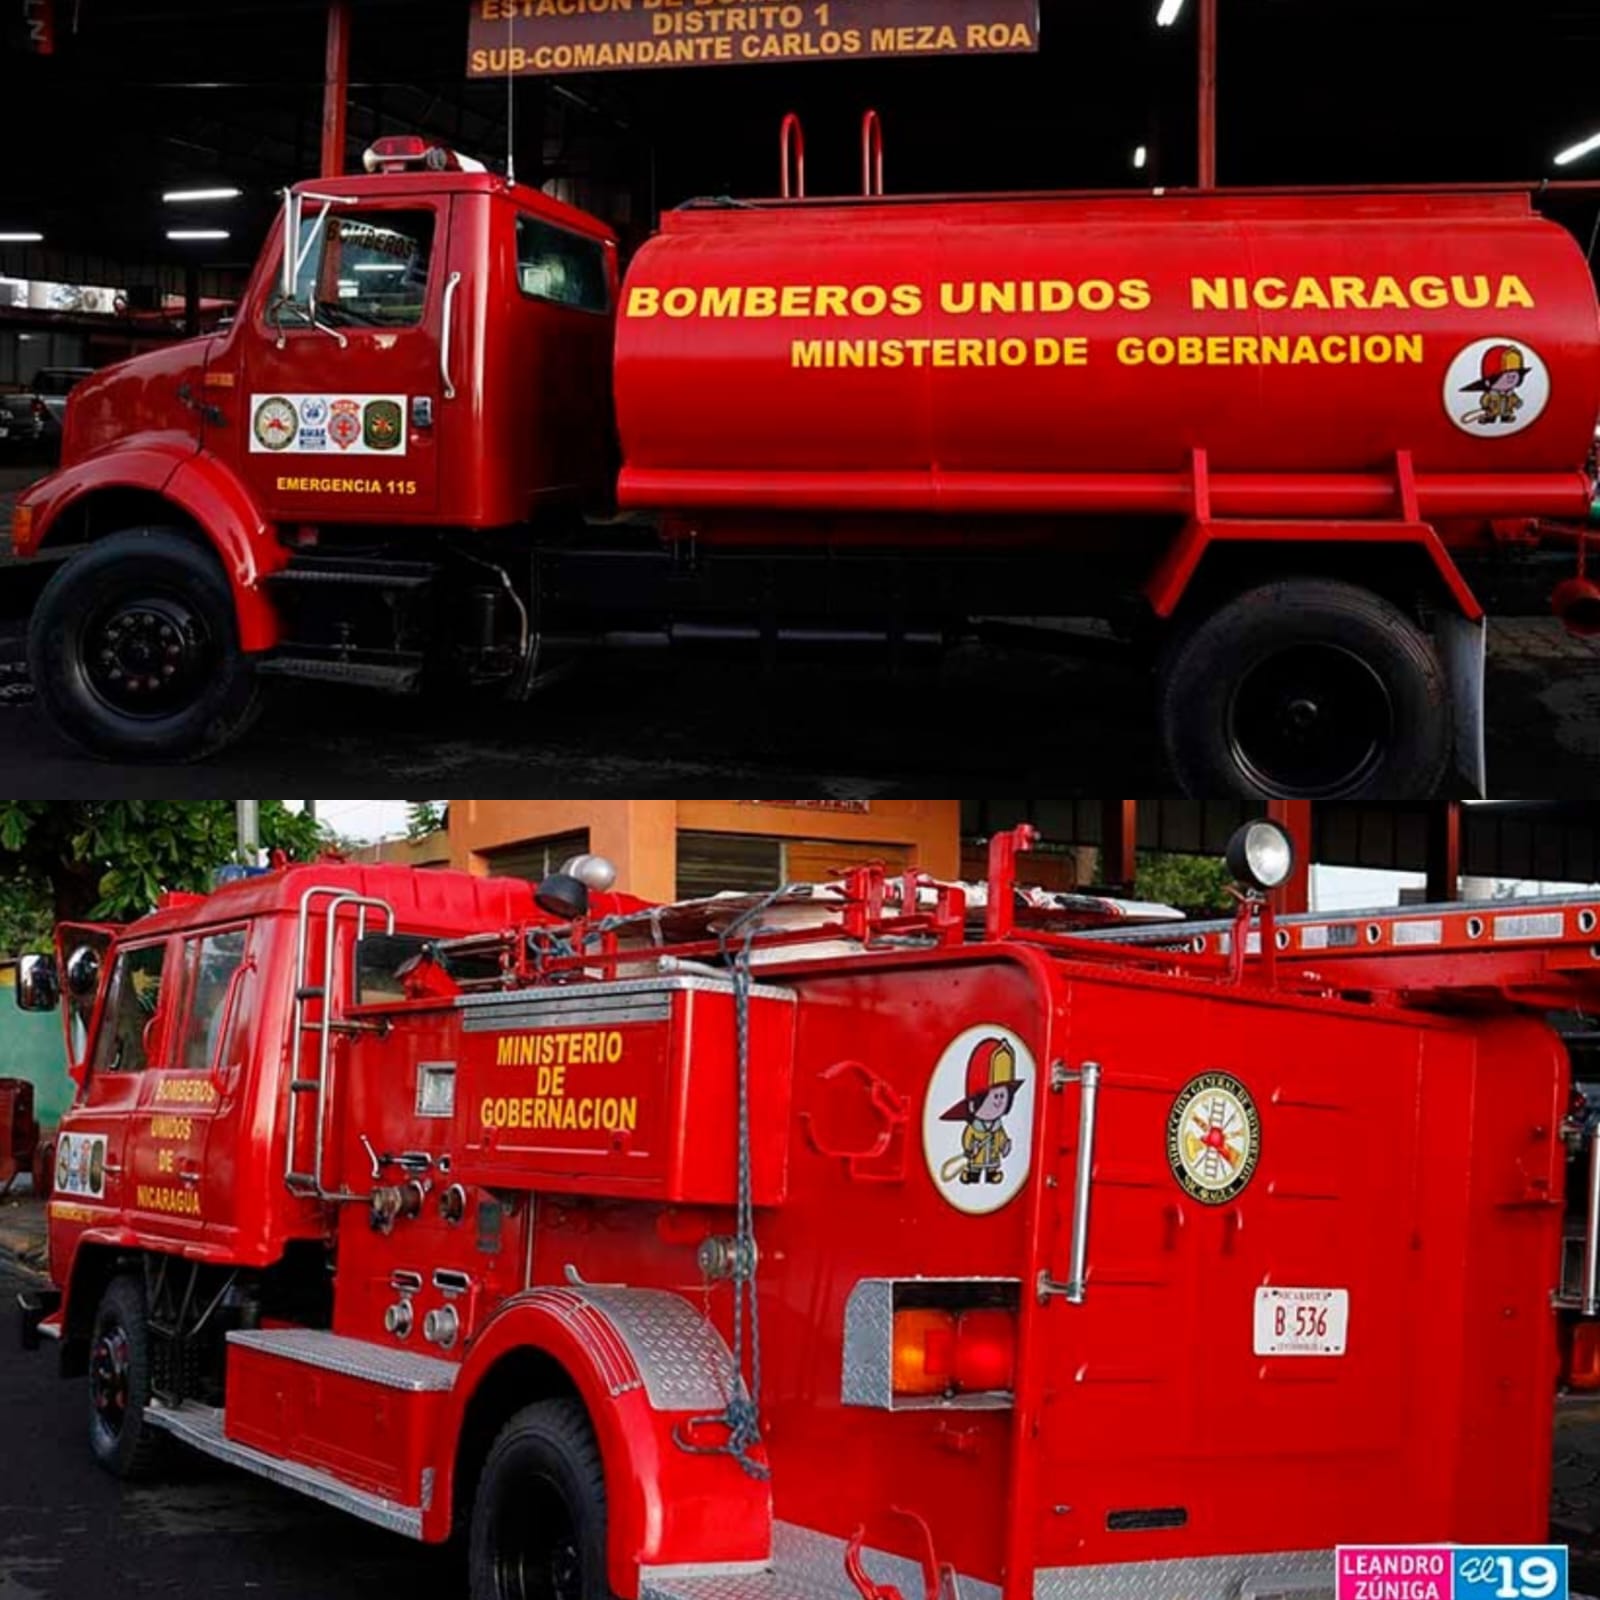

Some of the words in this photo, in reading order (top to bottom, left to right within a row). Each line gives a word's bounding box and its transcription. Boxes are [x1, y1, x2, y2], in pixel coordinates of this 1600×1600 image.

[652, 6, 802, 35] DISTRITO
[813, 3, 829, 26] 1
[471, 37, 732, 72] SUB-COMANDANTE
[742, 30, 861, 58] CARLOS
[870, 25, 956, 51] MEZA
[966, 23, 1032, 48] ROA
[626, 284, 922, 318] BOMBEROS
[940, 278, 1151, 314] UNIDOS
[1190, 275, 1535, 309] NICARAGUA
[791, 337, 1027, 368] MINISTERIO
[1034, 337, 1088, 366] DE
[1117, 333, 1424, 366] GOBERNACION
[276, 477, 382, 493] EMERGENCIA
[386, 480, 417, 494] 115
[496, 1031, 623, 1067] MINISTERIO
[155, 1078, 216, 1103] BOMBEROS
[536, 1065, 566, 1097] DE
[150, 1114, 193, 1141] UNIDOS
[480, 1097, 637, 1130] GOBERNACION
[158, 1148, 174, 1173] DE
[136, 1185, 201, 1215] NICARAGUA
[1275, 1305, 1286, 1337] B
[1295, 1305, 1328, 1337] 536
